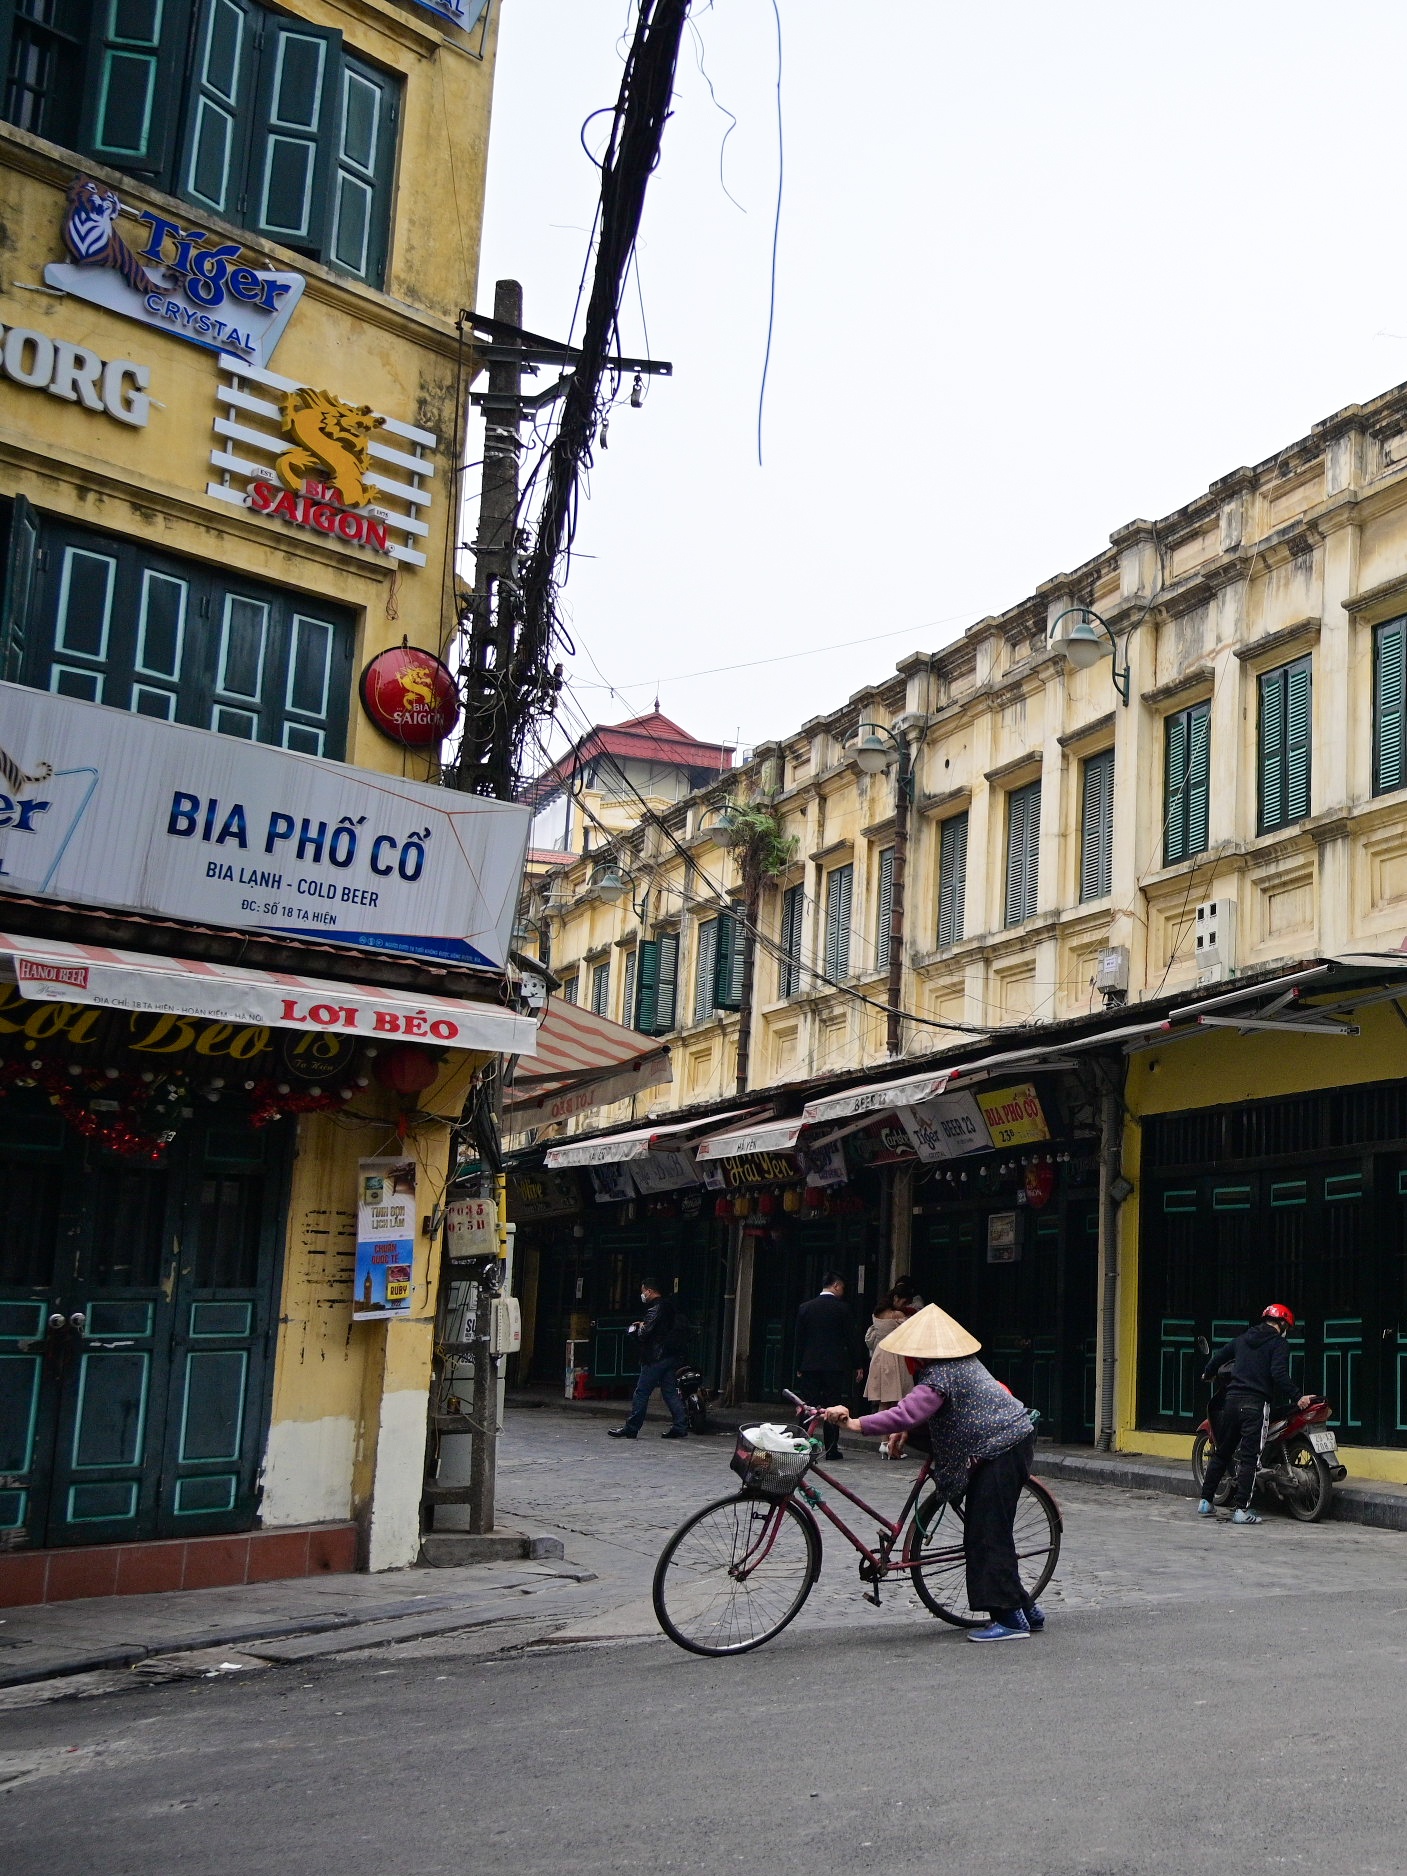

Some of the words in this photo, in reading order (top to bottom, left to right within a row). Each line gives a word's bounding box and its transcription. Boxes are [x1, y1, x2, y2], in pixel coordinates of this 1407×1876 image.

[139, 209, 292, 312] Tiger
[146, 294, 257, 352] CRYSTAL
[0, 323, 149, 428] ORG
[305, 479, 346, 506] BIA
[250, 481, 389, 551] SAIGON
[413, 703, 430, 712] BIA
[167, 790, 249, 850] BIA
[264, 811, 368, 869] PHỐ
[370, 826, 432, 883] CỔ
[206, 861, 234, 882] BIA
[238, 866, 283, 890] LẠNH
[297, 878, 337, 900] COLD
[341, 887, 379, 908] BEER
[241, 899, 261, 913] ĐC:
[263, 901, 279, 915] SỐ
[281, 906, 294, 918] 18
[296, 908, 310, 922] TẠ
[313, 911, 338, 926] HIỆN
[21, 960, 57, 980] HANOI
[59, 967, 86, 986] BEER
[132, 1000, 141, 1009] 18
[280, 999, 359, 1030] LỢI
[372, 1009, 459, 1040] BÉO
[913, 1126, 940, 1149] Tiger
[941, 1118, 965, 1138] BEER
[962, 1116, 977, 1134] 23
[984, 1106, 1005, 1127] BIA
[390, 1284, 408, 1296] RUBY
